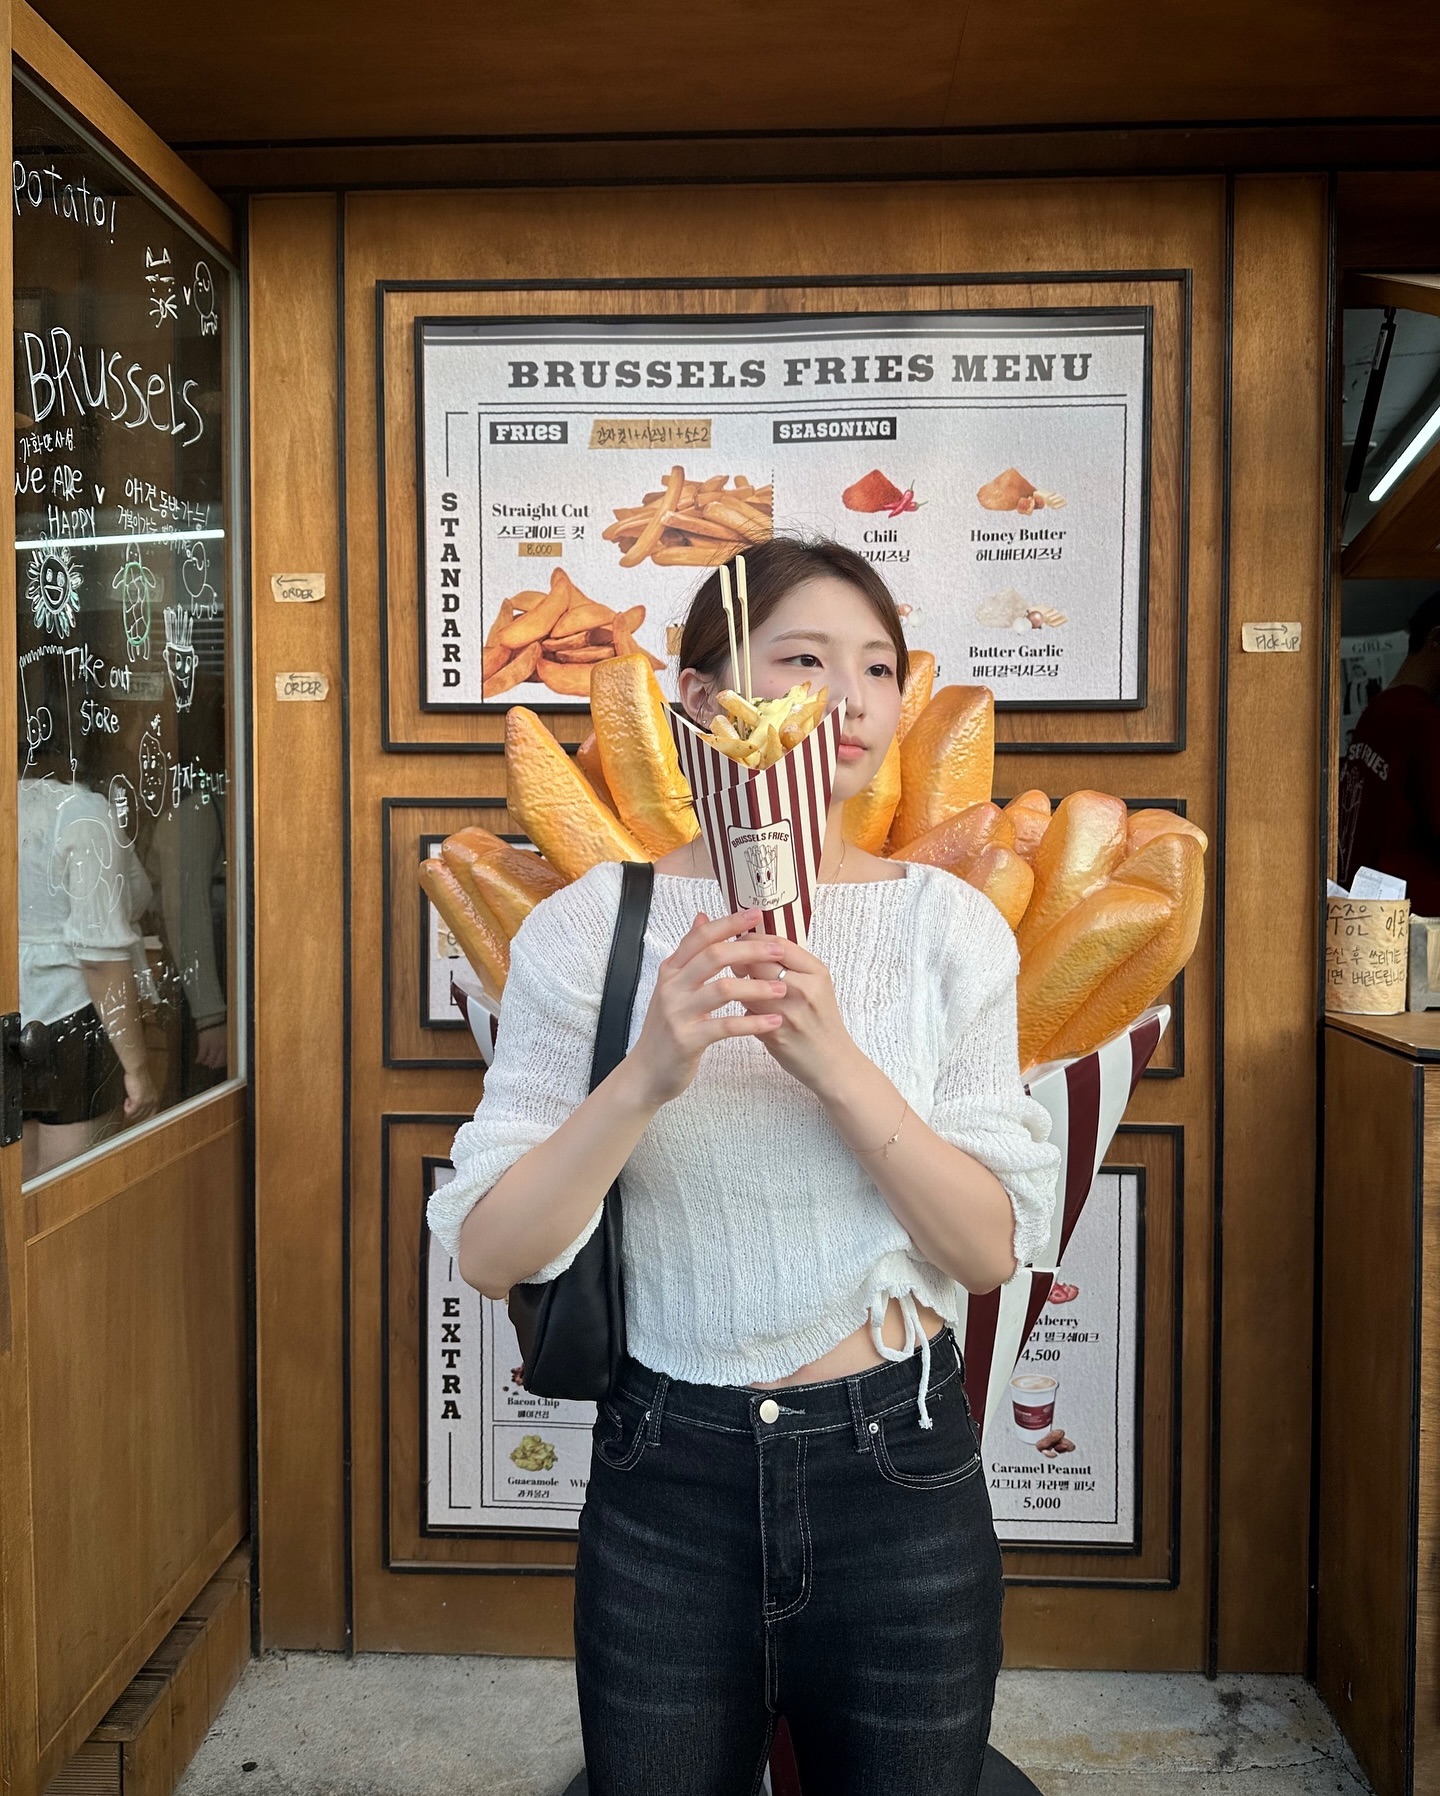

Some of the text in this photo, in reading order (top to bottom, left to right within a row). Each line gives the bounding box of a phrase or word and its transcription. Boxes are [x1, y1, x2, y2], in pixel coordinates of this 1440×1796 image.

[508, 353, 1092, 388] BRUSSELS FRIES MENU
[779, 421, 891, 439] SEASONING
[492, 503, 590, 520] Straight Cut
[497, 525, 585, 540] 스트레이트 컷
[863, 530, 898, 543] Chili
[970, 529, 1067, 544] Honey Butter
[858, 550, 911, 563] 리시즈닝
[976, 547, 1063, 561] 허니버터시즈닝
[282, 587, 314, 599] ORDER
[440, 492, 461, 687] STANDARD
[969, 645, 1064, 658] Butter Garlic
[972, 665, 1059, 677] 버터갈릭시즈닝
[284, 681, 322, 696] ORDER
[731, 831, 790, 848] BRUSSELS FRIES
[1350, 946, 1363, 965] 후
[1035, 1315, 1080, 1329] wberry
[441, 1298, 461, 1419] EXTRA
[1021, 1349, 1061, 1362] 4,500
[507, 1397, 560, 1409] Bacon Chip
[991, 1463, 1092, 1476] Caramel Peanut
[507, 1476, 560, 1486] Guacamole
[1023, 1497, 1062, 1510] 5,000
